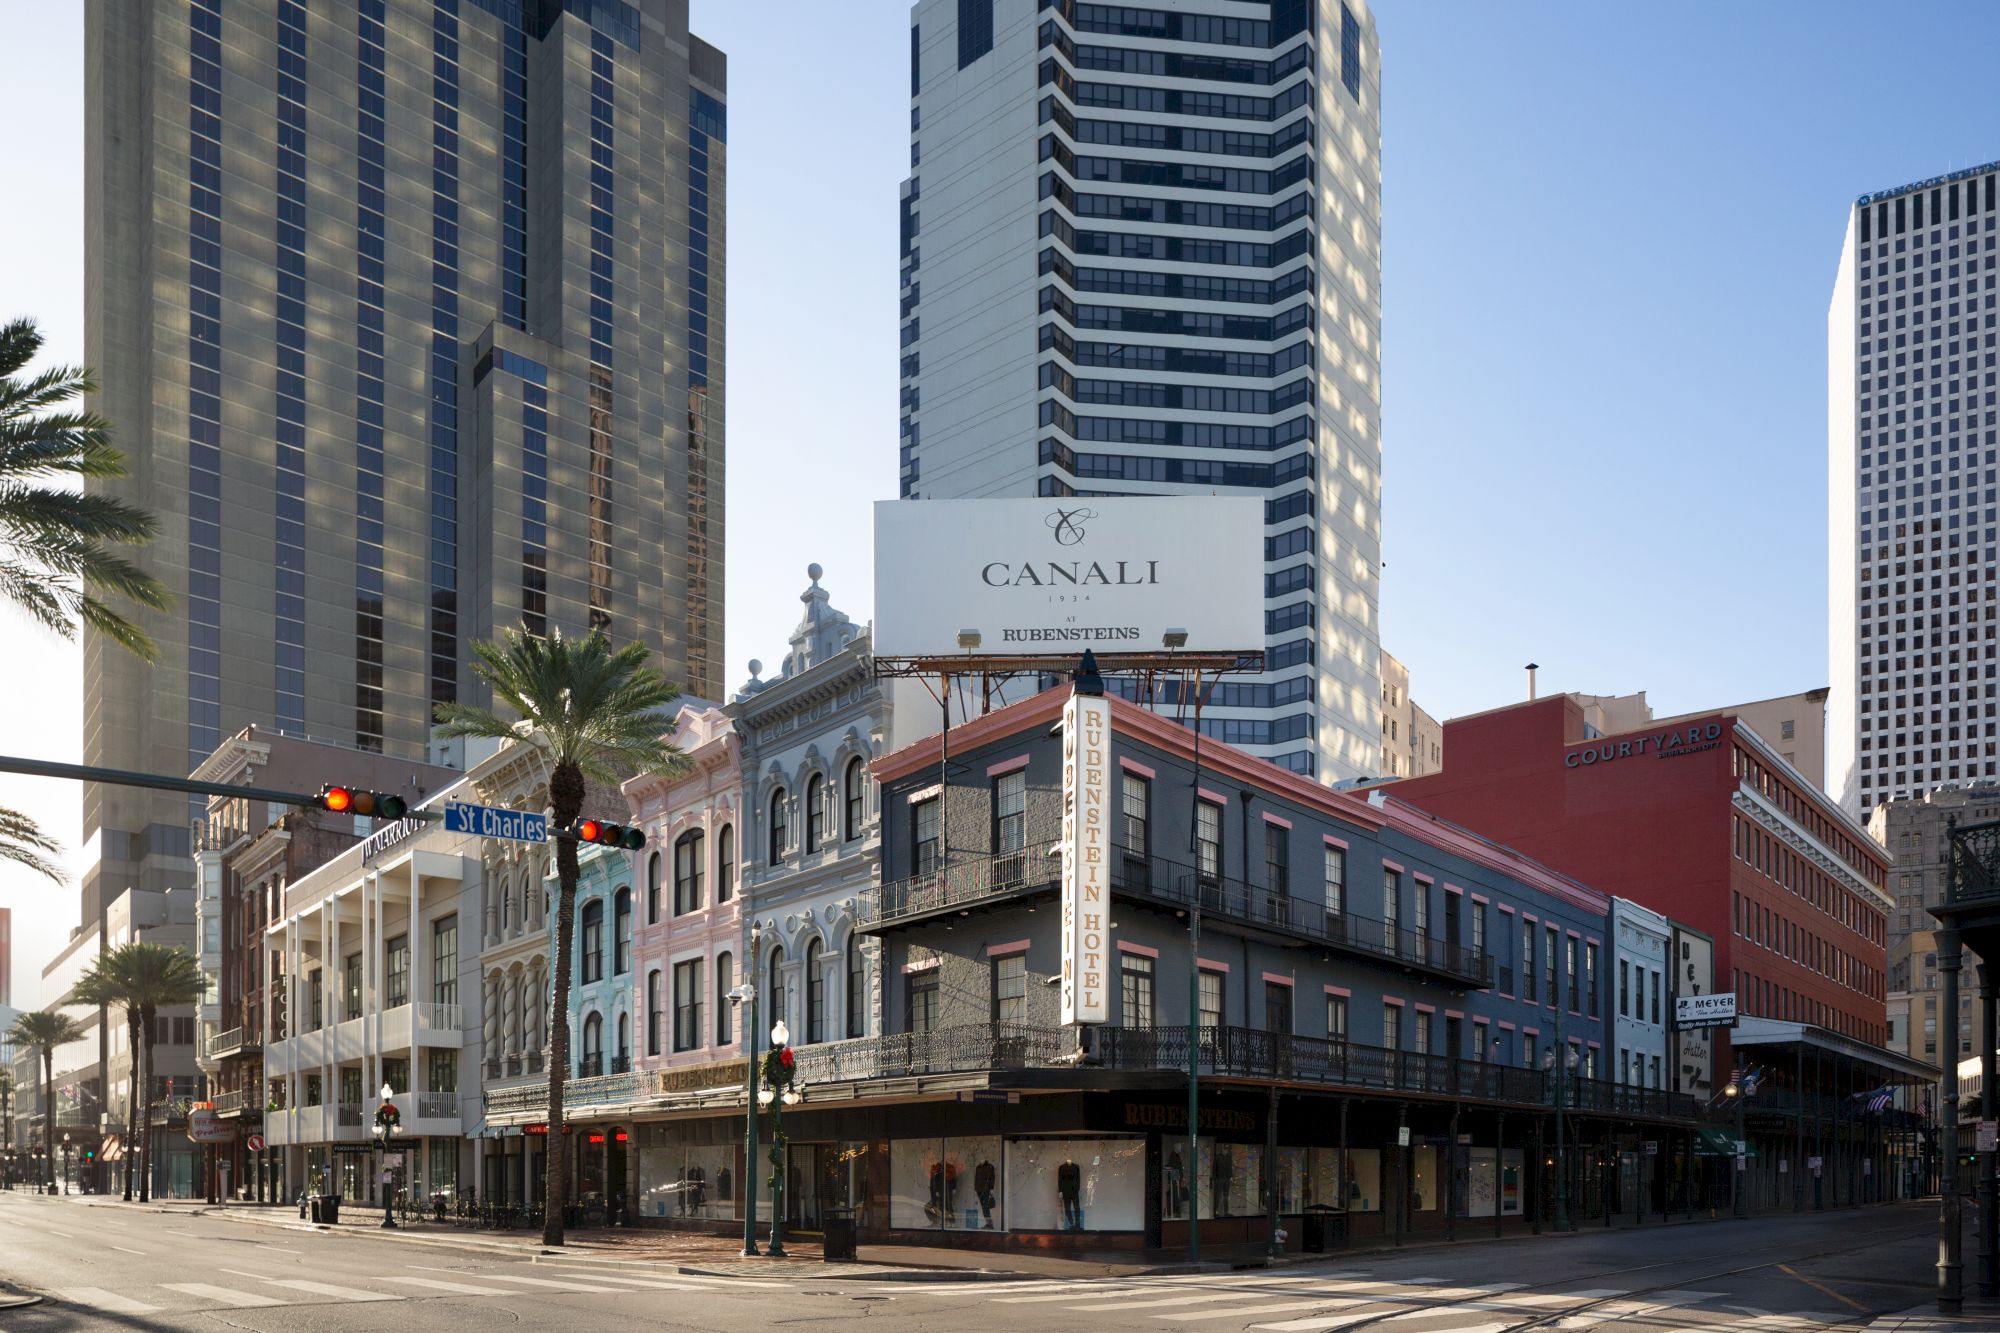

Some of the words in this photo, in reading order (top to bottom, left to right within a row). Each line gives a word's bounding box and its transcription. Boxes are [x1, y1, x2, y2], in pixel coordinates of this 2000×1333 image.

[982, 561, 1159, 586] CANALI
[1002, 627, 1140, 642] RUBENSTEINS
[1564, 723, 1722, 768] COURTYARD
[459, 805, 475, 832] St
[483, 809, 545, 841] Charles
[1084, 711, 1102, 902] RUBENSTEIN
[1064, 709, 1074, 1009] RUBENSTEINS
[1084, 914, 1101, 1008] HOTEL
[1696, 998, 1733, 1009] MEYER
